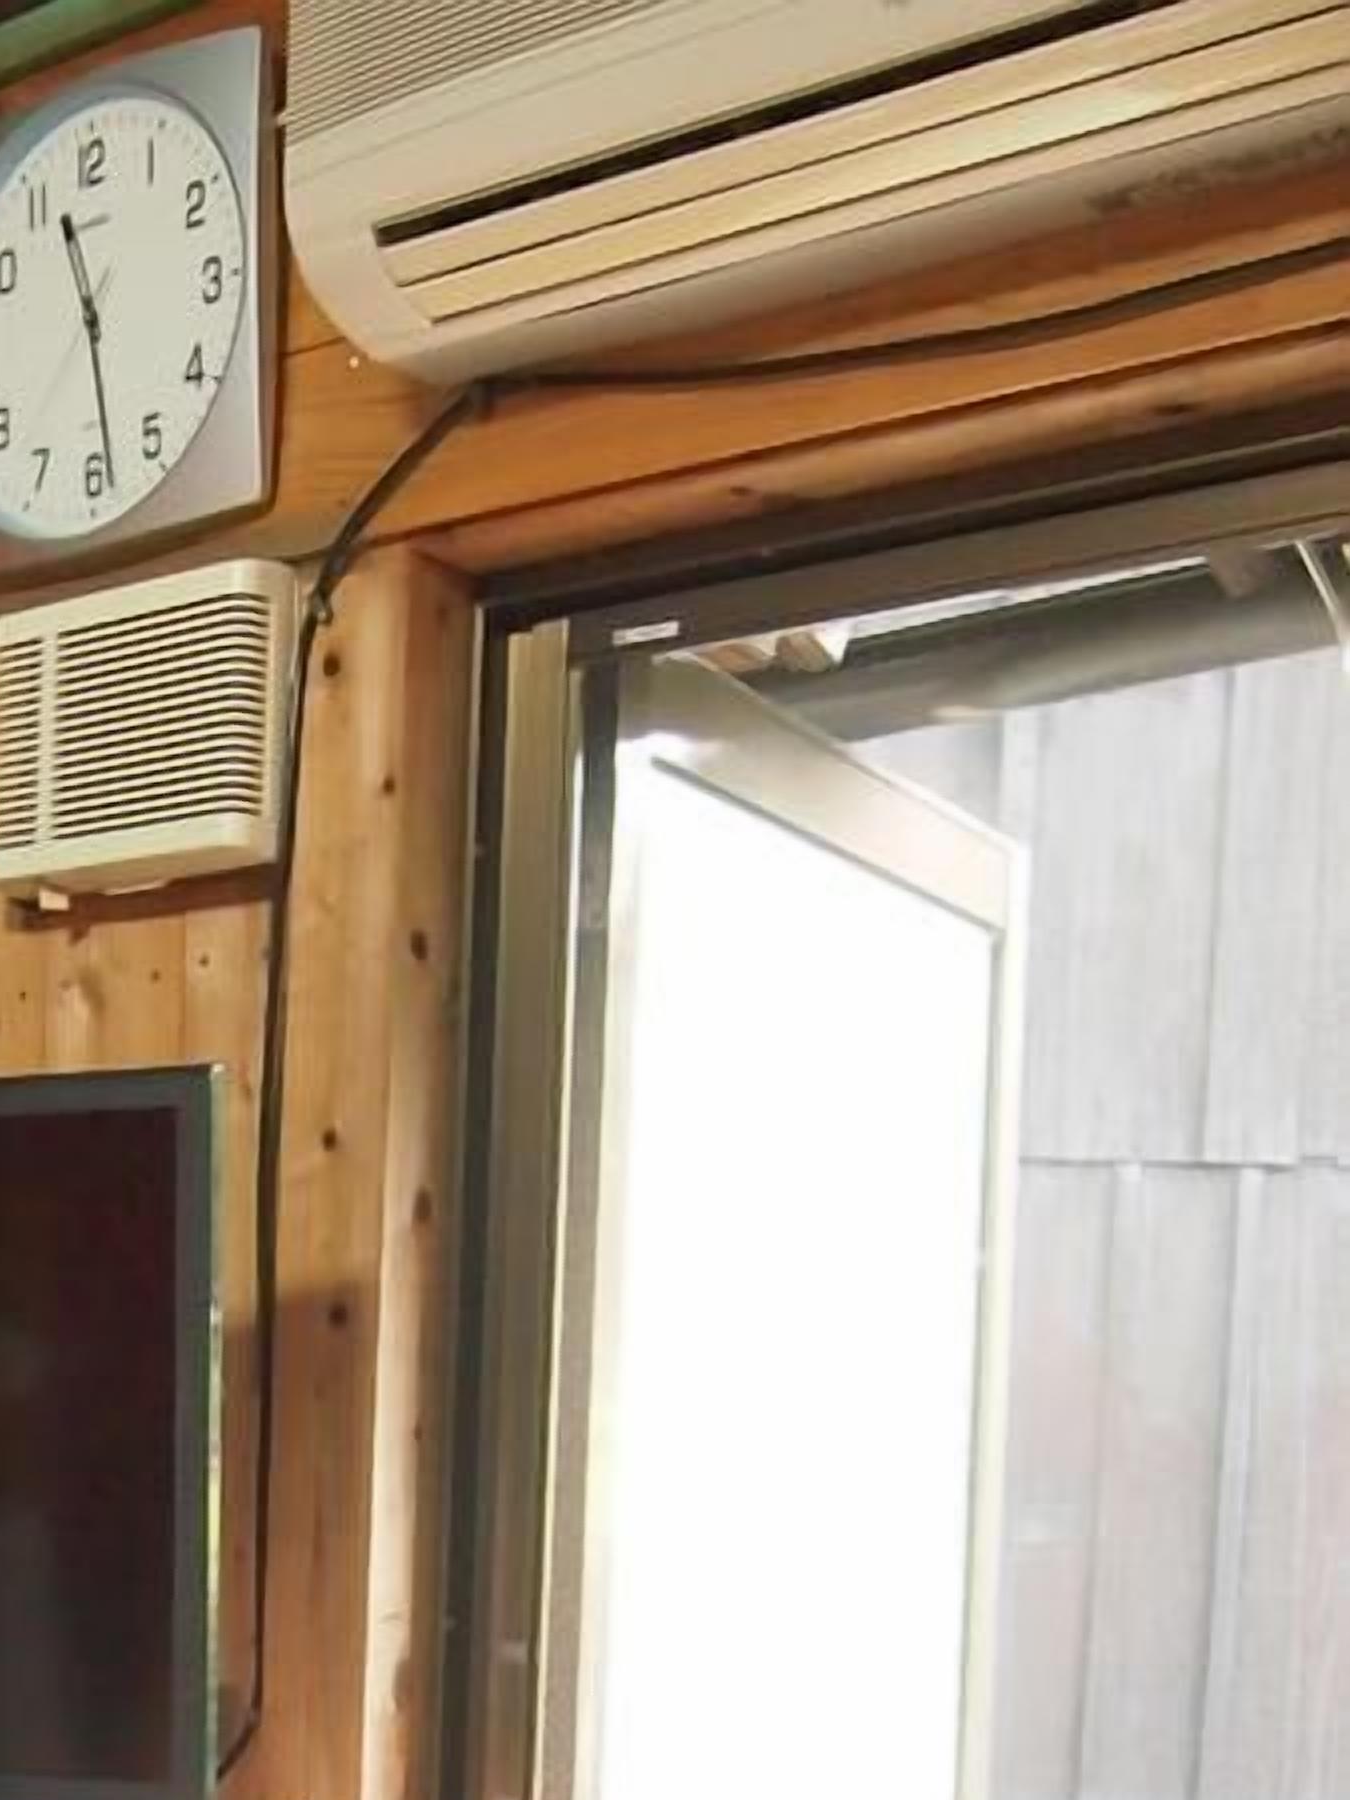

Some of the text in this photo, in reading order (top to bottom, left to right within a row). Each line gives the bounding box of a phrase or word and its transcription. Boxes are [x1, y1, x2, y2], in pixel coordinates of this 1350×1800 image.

[77, 138, 107, 188] 12
[28, 183, 48, 232] 11
[185, 179, 208, 229] 2
[201, 255, 224, 304] 3
[184, 343, 205, 389] 4
[141, 412, 163, 461] 5
[30, 447, 52, 493] 7
[84, 453, 105, 498] 6
